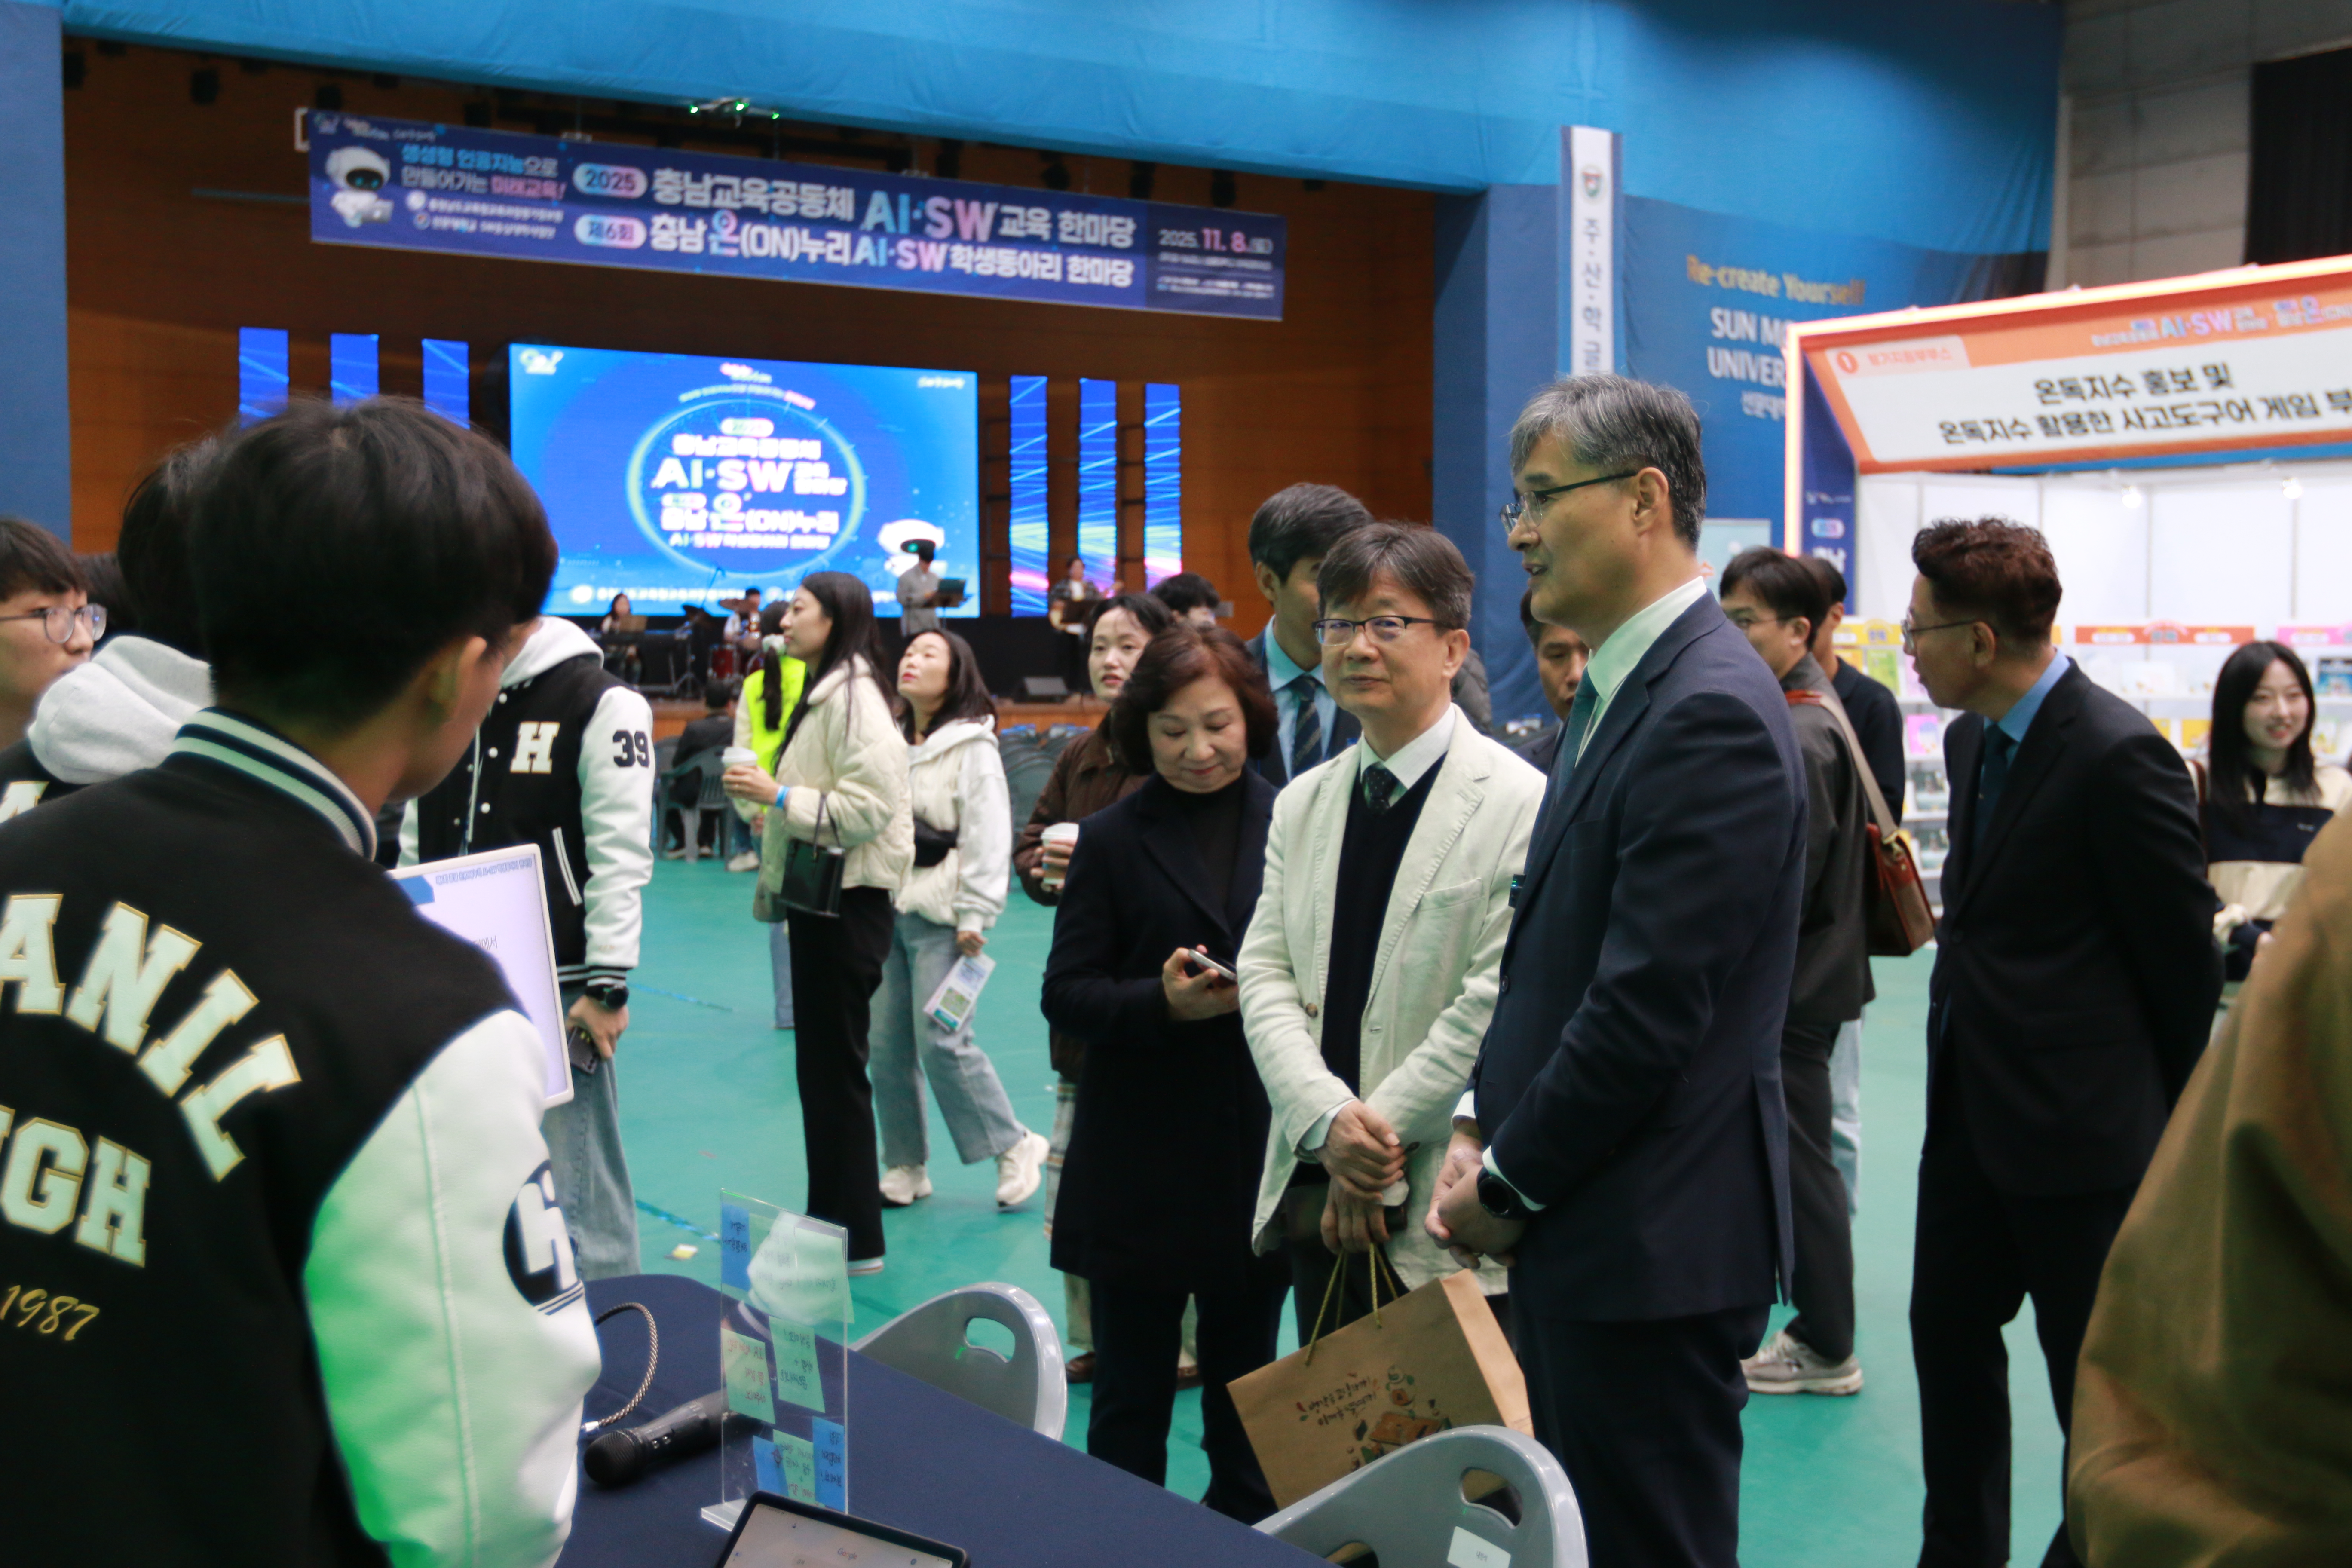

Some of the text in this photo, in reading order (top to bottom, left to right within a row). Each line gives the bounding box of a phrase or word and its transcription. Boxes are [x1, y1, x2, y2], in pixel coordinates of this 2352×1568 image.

[456, 148, 558, 178] 인공지능으로
[585, 169, 637, 192] 2025
[401, 165, 567, 201] 만들어가는 미래교육!
[653, 167, 855, 222] 충남교육공동체
[1057, 209, 1136, 249] 한마당
[587, 219, 635, 242] 제6회
[650, 213, 707, 254] 충남
[1066, 254, 1135, 288] 한마당
[1687, 254, 1866, 306] Re-create Yourself
[1710, 306, 1757, 342] SUN
[2142, 368, 2201, 398] 홍보
[2204, 362, 2236, 390] 및
[2035, 409, 2116, 438] 활용한
[2122, 395, 2257, 432] 사고도구어
[2258, 392, 2322, 421] 게임
[510, 721, 560, 773] H
[612, 729, 650, 768] 39
[0, 1285, 100, 1341] 1987
[837, 1547, 858, 1561] Google
